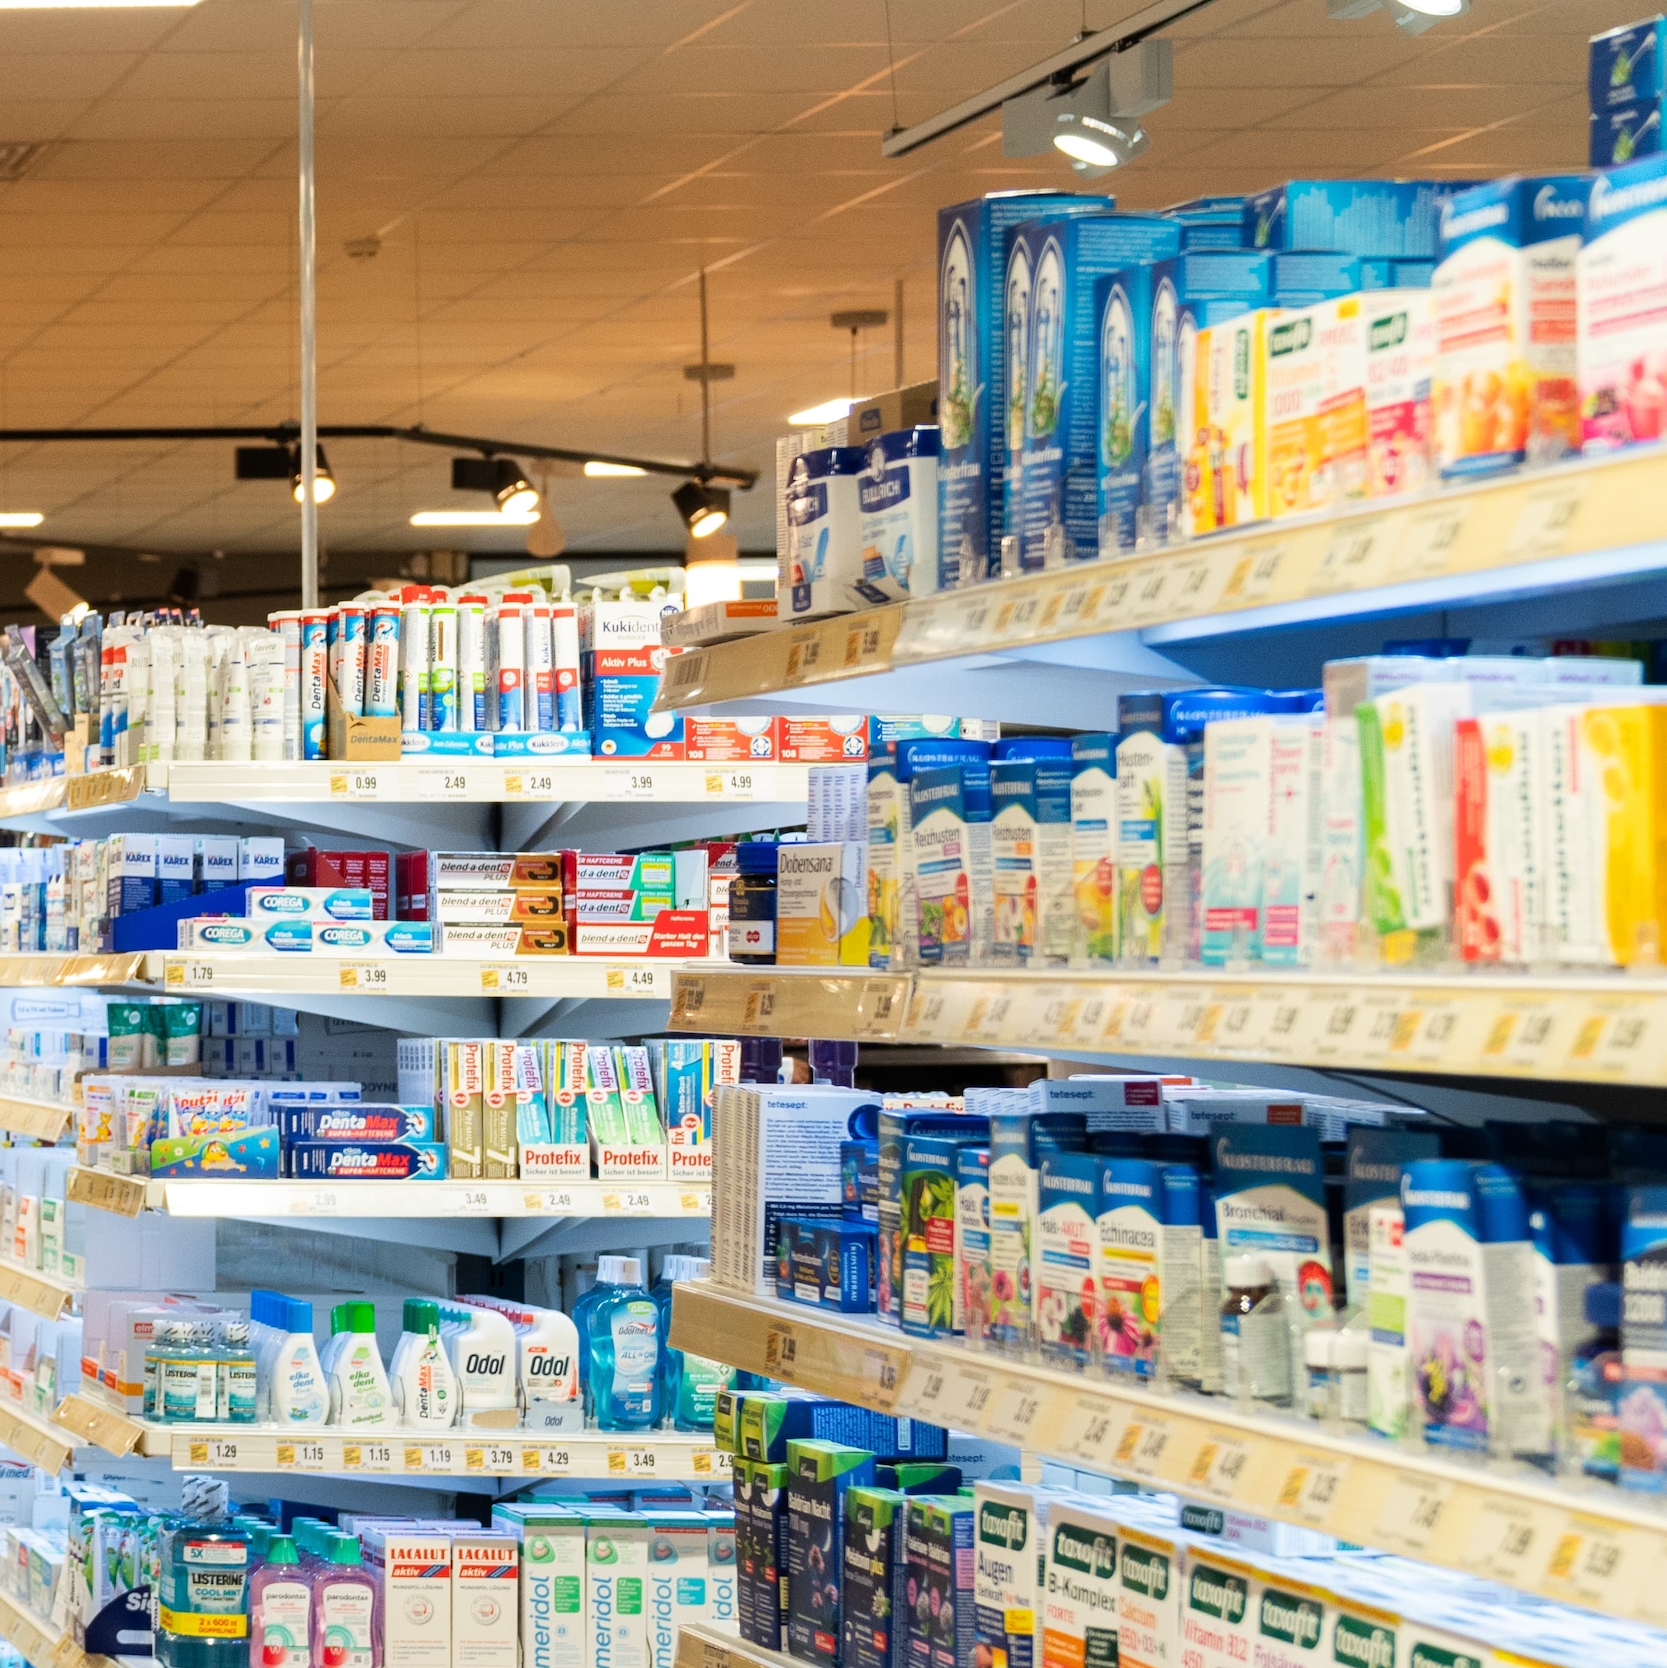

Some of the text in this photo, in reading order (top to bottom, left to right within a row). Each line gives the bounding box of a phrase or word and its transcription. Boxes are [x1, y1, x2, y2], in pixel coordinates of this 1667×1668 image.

[602, 620, 660, 634] Kukident
[601, 656, 648, 669] Aktiv Plus
[688, 751, 704, 760] 108
[355, 777, 377, 790] 0.99
[444, 776, 466, 789] 2.49
[530, 777, 552, 790] 2.49
[631, 776, 653, 790] 3.99
[730, 776, 753, 790] 4.99
[163, 855, 189, 866] KAREX
[207, 856, 234, 867] KAREX
[253, 855, 280, 866] KAREX
[484, 872, 509, 882] PLUS
[263, 897, 304, 908] COREGA
[204, 927, 245, 939] COREGA
[324, 929, 364, 941] COREGA
[490, 940, 515, 950] PLUS
[192, 967, 213, 980] 1.79
[366, 970, 387, 982] 3.99
[507, 971, 528, 984] 4.79
[632, 971, 653, 984] 4.49
[320, 1115, 399, 1129] DentaMax
[331, 1153, 410, 1167] DentaMax
[525, 1149, 581, 1167] Protefix
[603, 1149, 659, 1167] Protefix
[628, 1194, 649, 1206] 2.49
[466, 1354, 506, 1376] Odol
[530, 1356, 570, 1376] Odol
[289, 1370, 310, 1381] elka
[293, 1377, 314, 1388] dent
[216, 1445, 237, 1458] 1.29
[303, 1448, 324, 1461] 1.15
[369, 1449, 390, 1461] 1.15
[430, 1450, 451, 1463] 1.19
[491, 1450, 513, 1464] 3.79
[547, 1451, 569, 1465] 4.29
[633, 1453, 655, 1467] 3.49
[391, 1548, 447, 1561] LACALUT
[457, 1548, 514, 1561] LACALUT
[392, 1567, 420, 1577] aktiv
[460, 1568, 488, 1578] aktiv
[326, 1593, 368, 1602] parodontax
